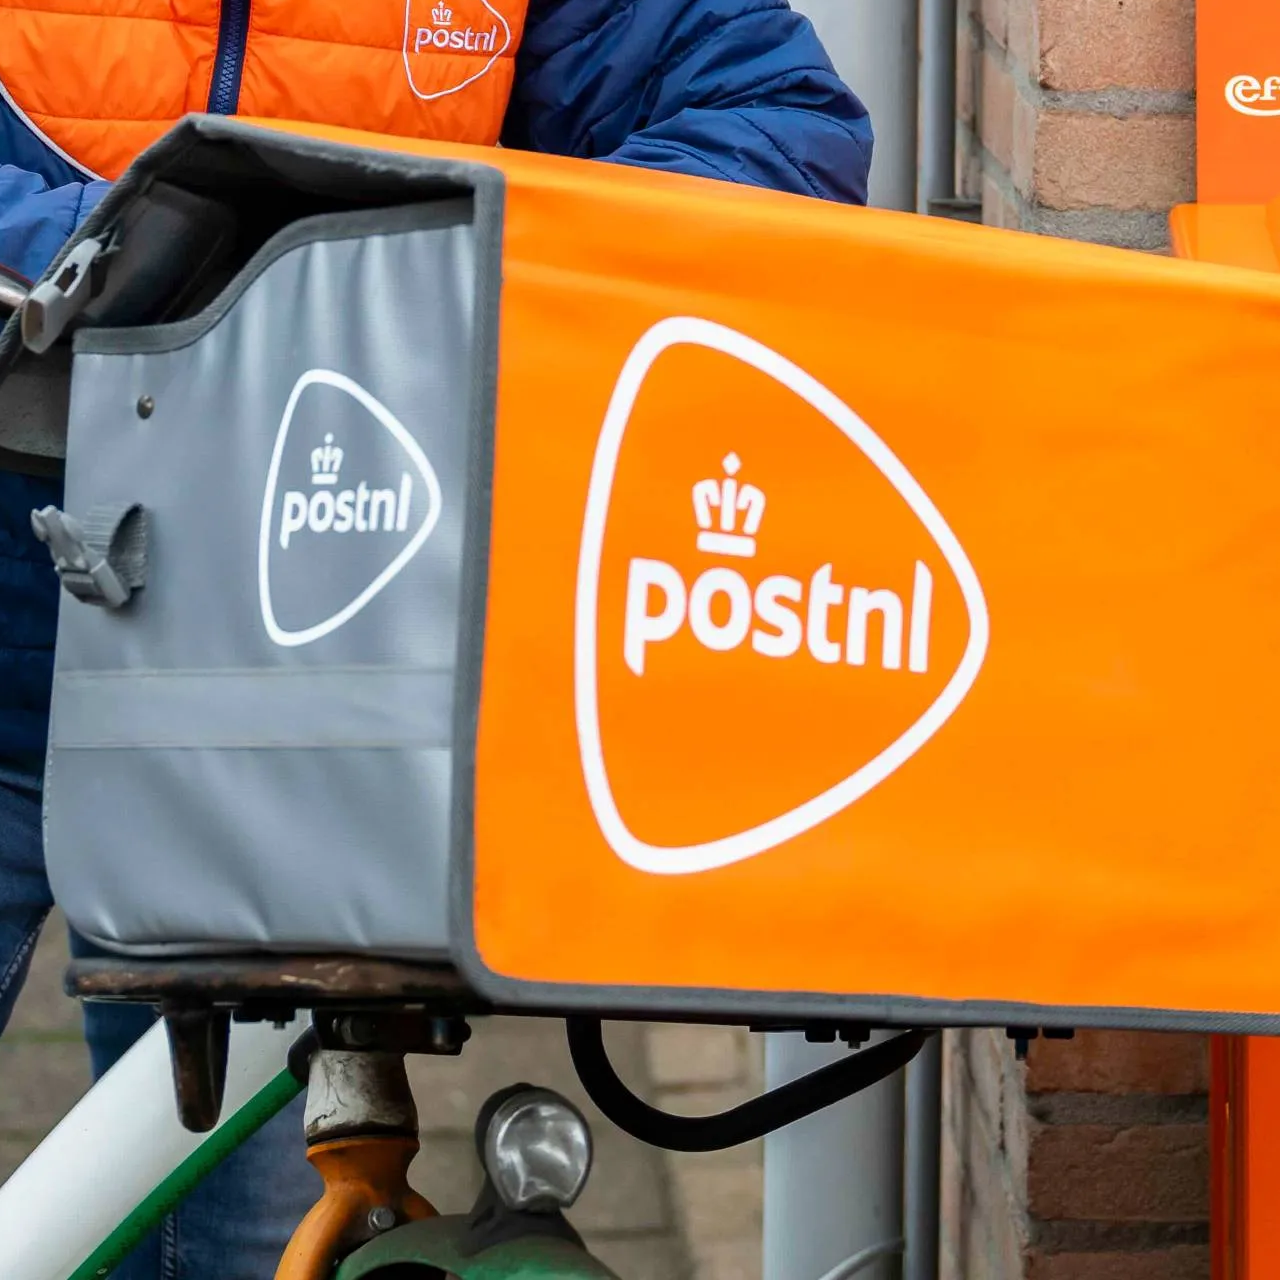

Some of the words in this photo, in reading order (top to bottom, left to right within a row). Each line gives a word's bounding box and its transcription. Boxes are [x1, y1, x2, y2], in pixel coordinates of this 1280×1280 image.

[414, 24, 498, 55] postnl
[280, 472, 412, 550] postnl
[623, 556, 934, 677] postnl
